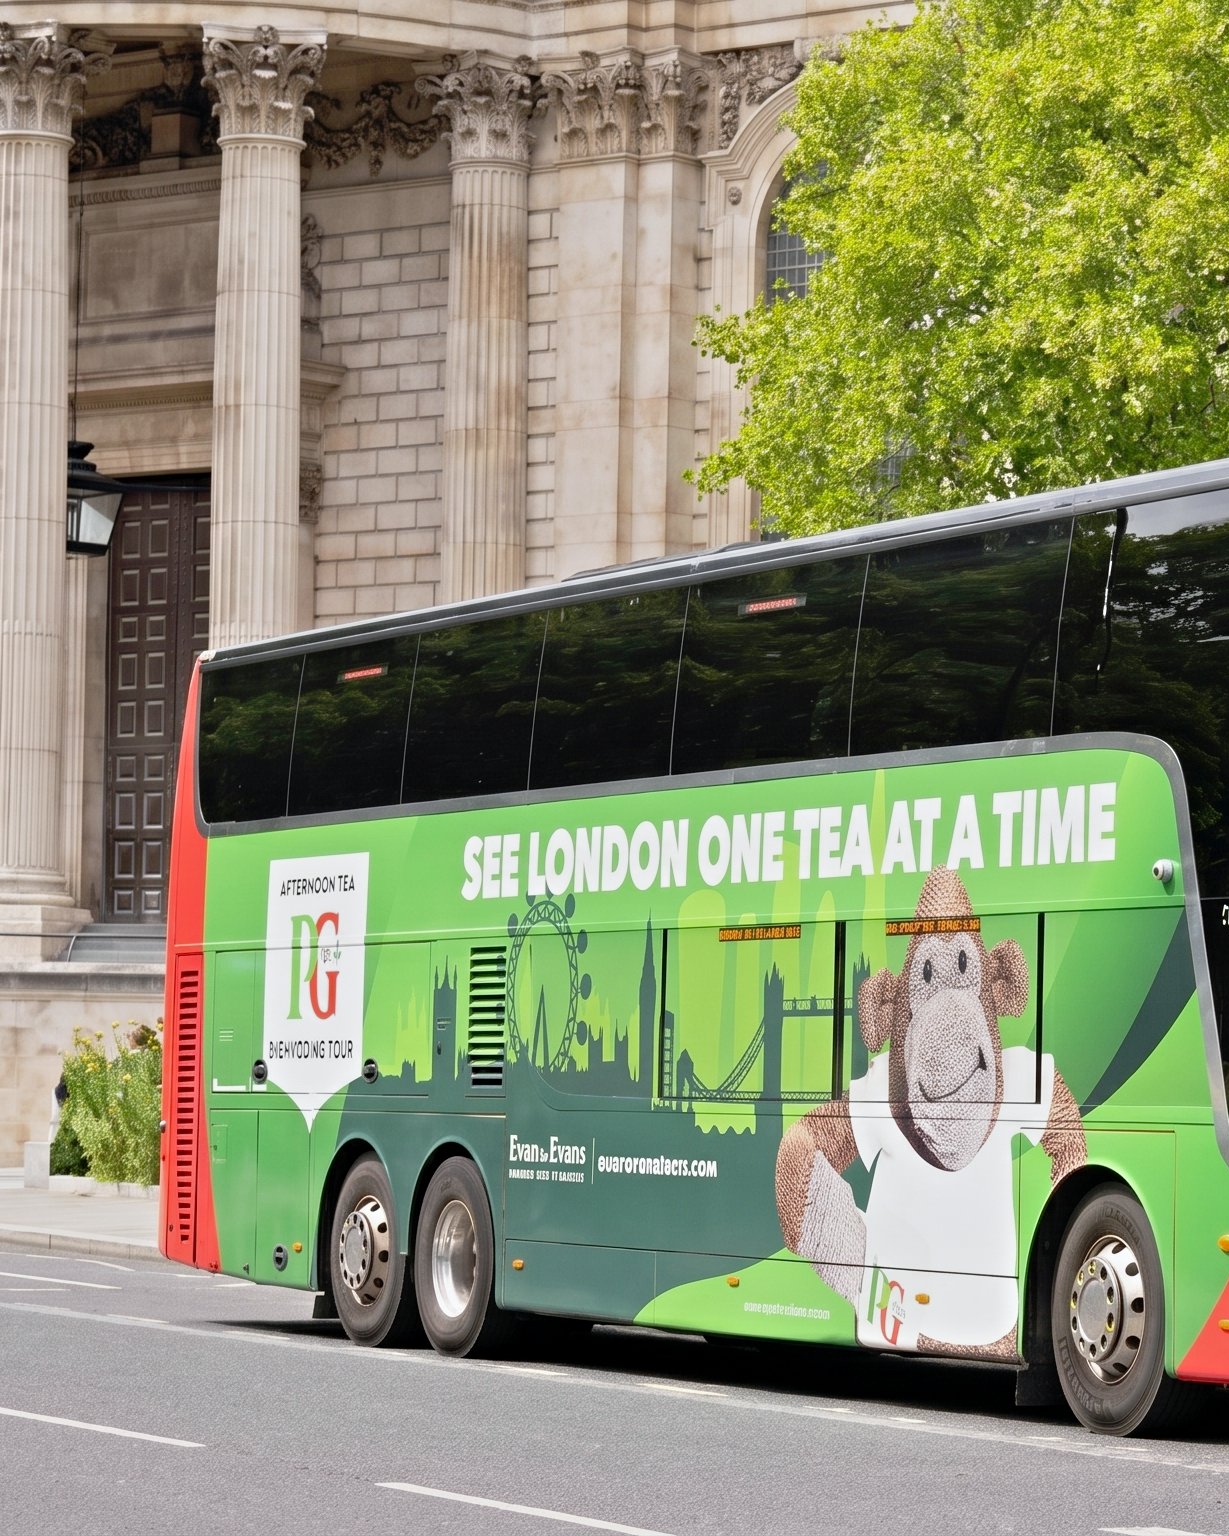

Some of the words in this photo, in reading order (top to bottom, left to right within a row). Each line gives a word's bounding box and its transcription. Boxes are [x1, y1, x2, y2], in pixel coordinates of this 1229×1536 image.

[461, 833, 521, 901] SEE
[527, 818, 690, 896] LONDON
[698, 811, 786, 886] ONE
[793, 804, 875, 880] TEA
[880, 796, 942, 874] AT
[946, 794, 985, 870] A
[992, 781, 1117, 868] TIME
[280, 876, 336, 897] AFTERNOON
[338, 874, 355, 893] TEA
[286, 911, 340, 1020] PG
[328, 1040, 353, 1059] TOUR
[509, 1134, 539, 1163] Evan
[549, 1136, 586, 1165] Evans
